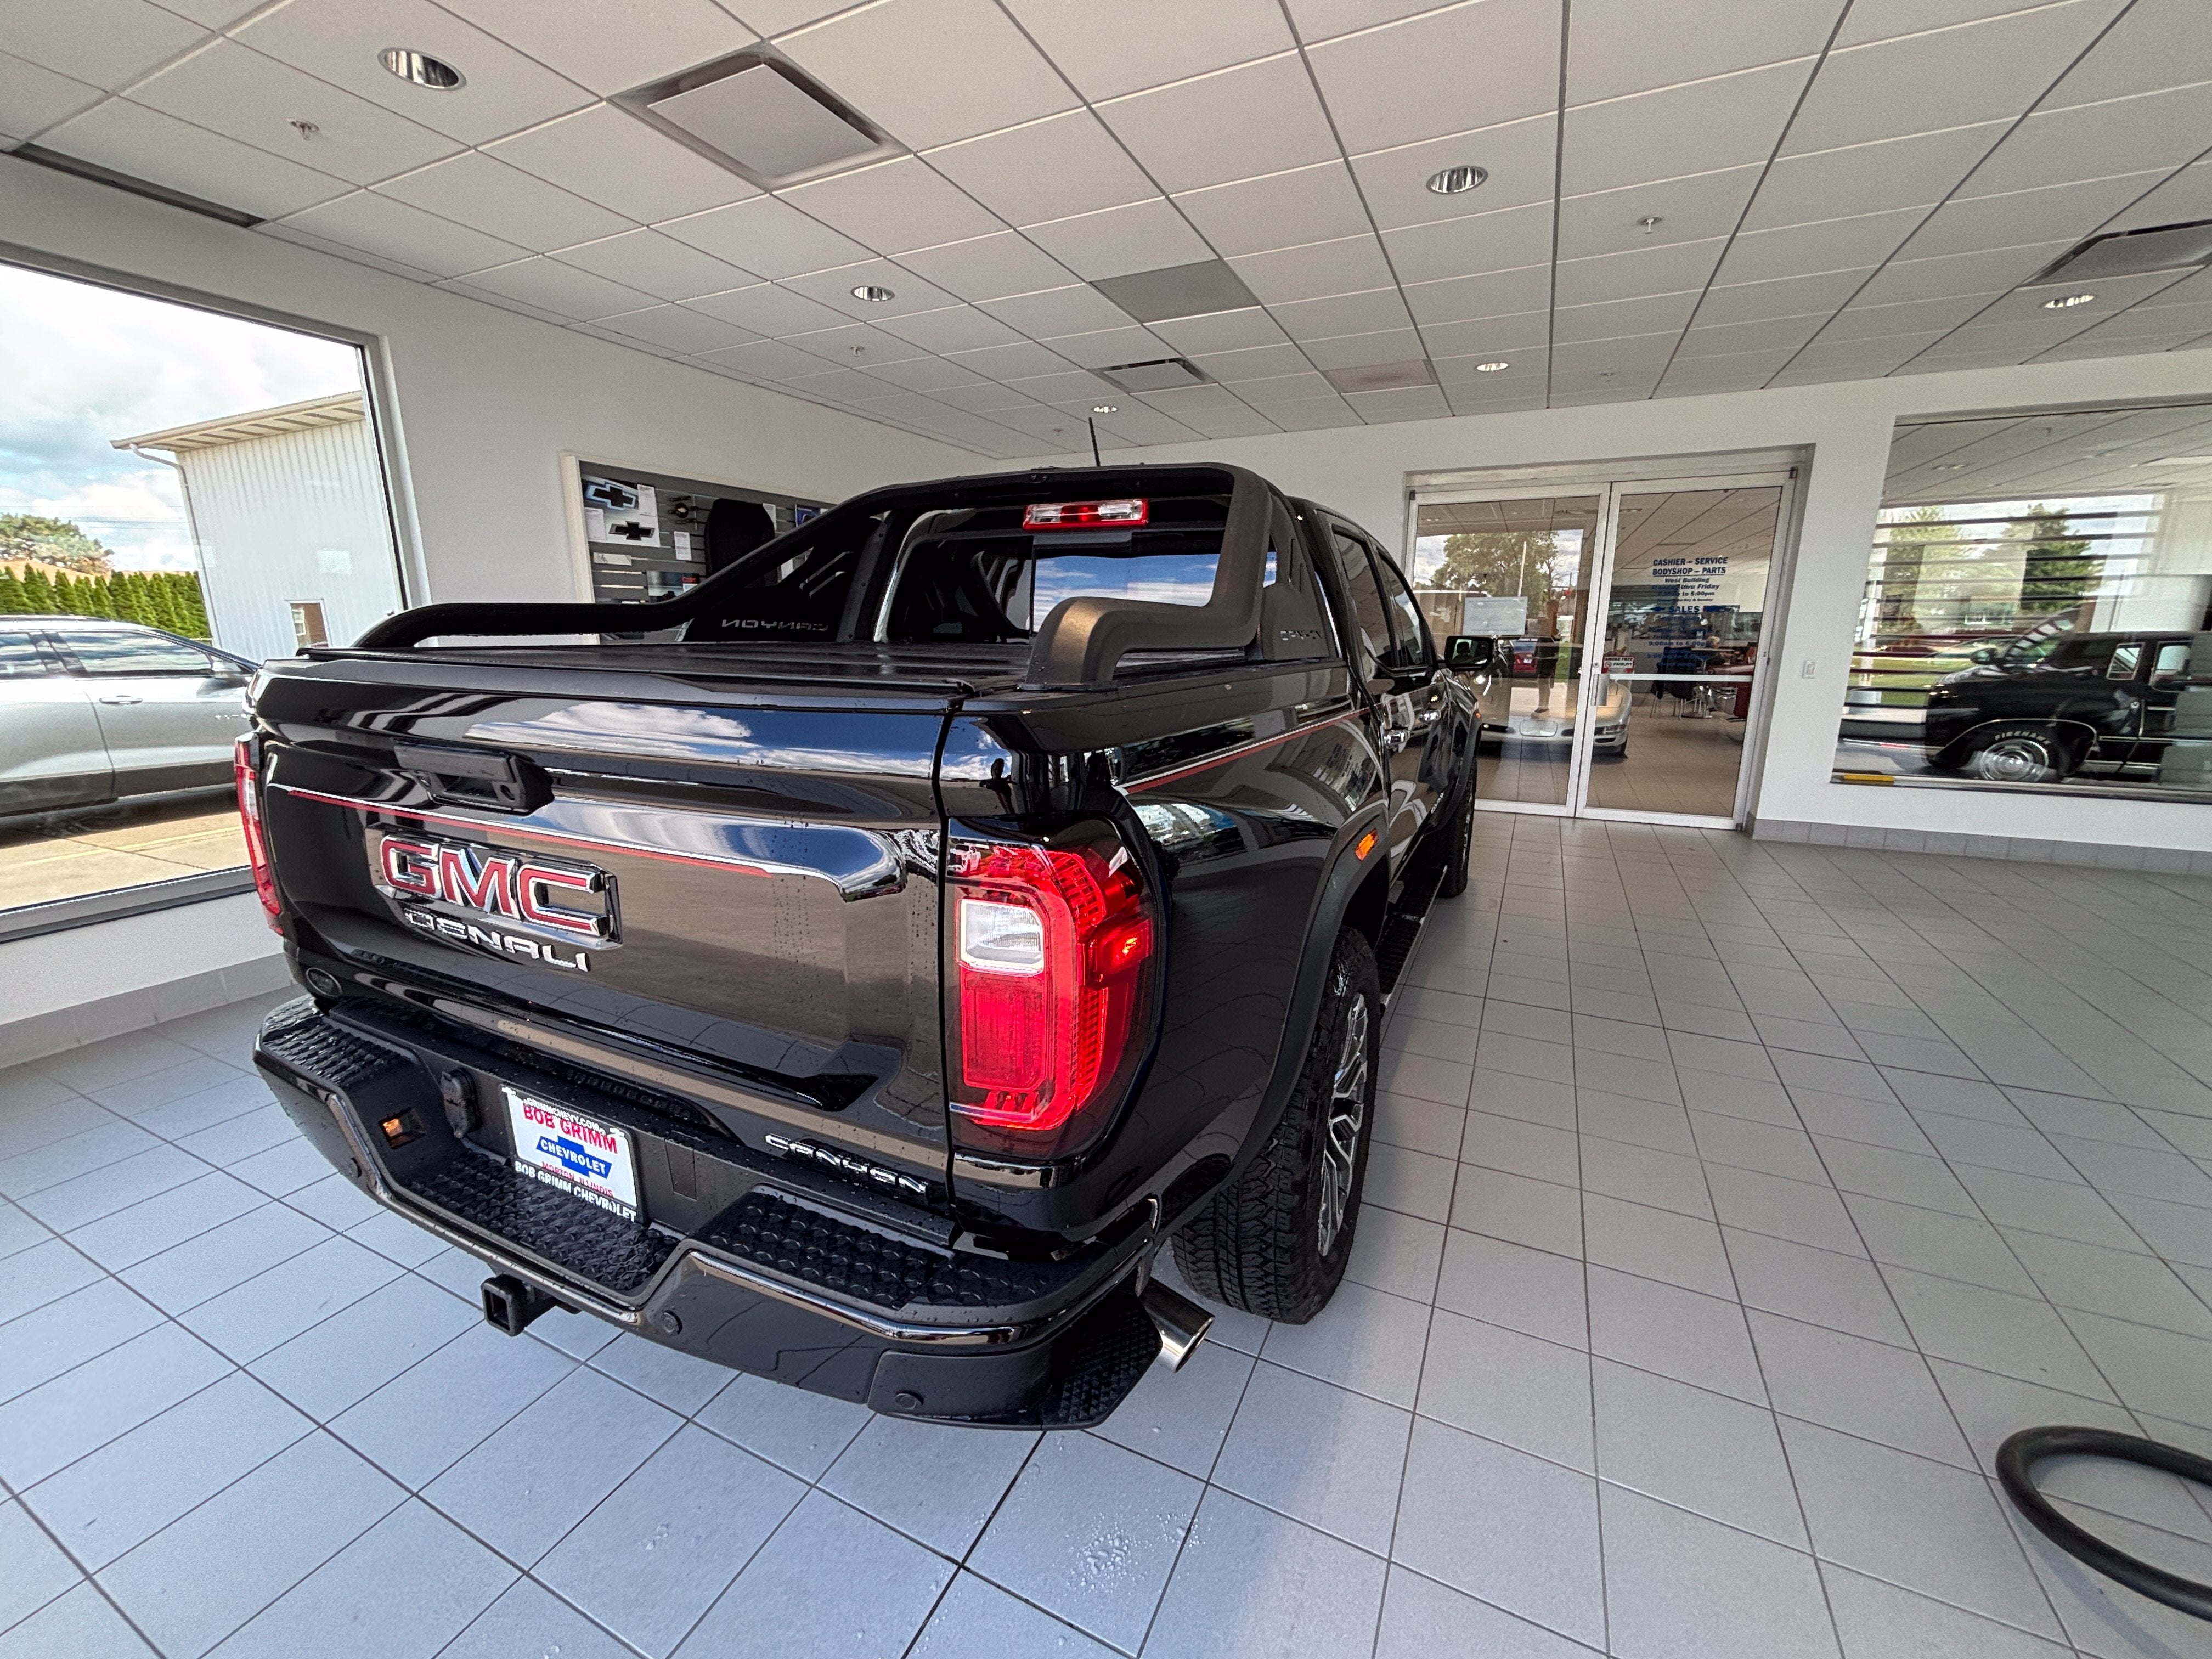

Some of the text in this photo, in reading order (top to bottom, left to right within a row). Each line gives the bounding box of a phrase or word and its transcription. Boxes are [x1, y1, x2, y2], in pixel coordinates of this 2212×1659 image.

[1652, 567, 1693, 575] BODYSHOP
[380, 834, 603, 936] GMC
[405, 909, 591, 972] DENALI
[523, 1104, 618, 1154] BOB GRIMM
[540, 1139, 606, 1175] CHEVROLET
[765, 1133, 929, 1194] CANYON
[515, 1161, 637, 1222] BOB GRIMM CHEVROLET
[579, 1177, 614, 1198] ILLINOIS
